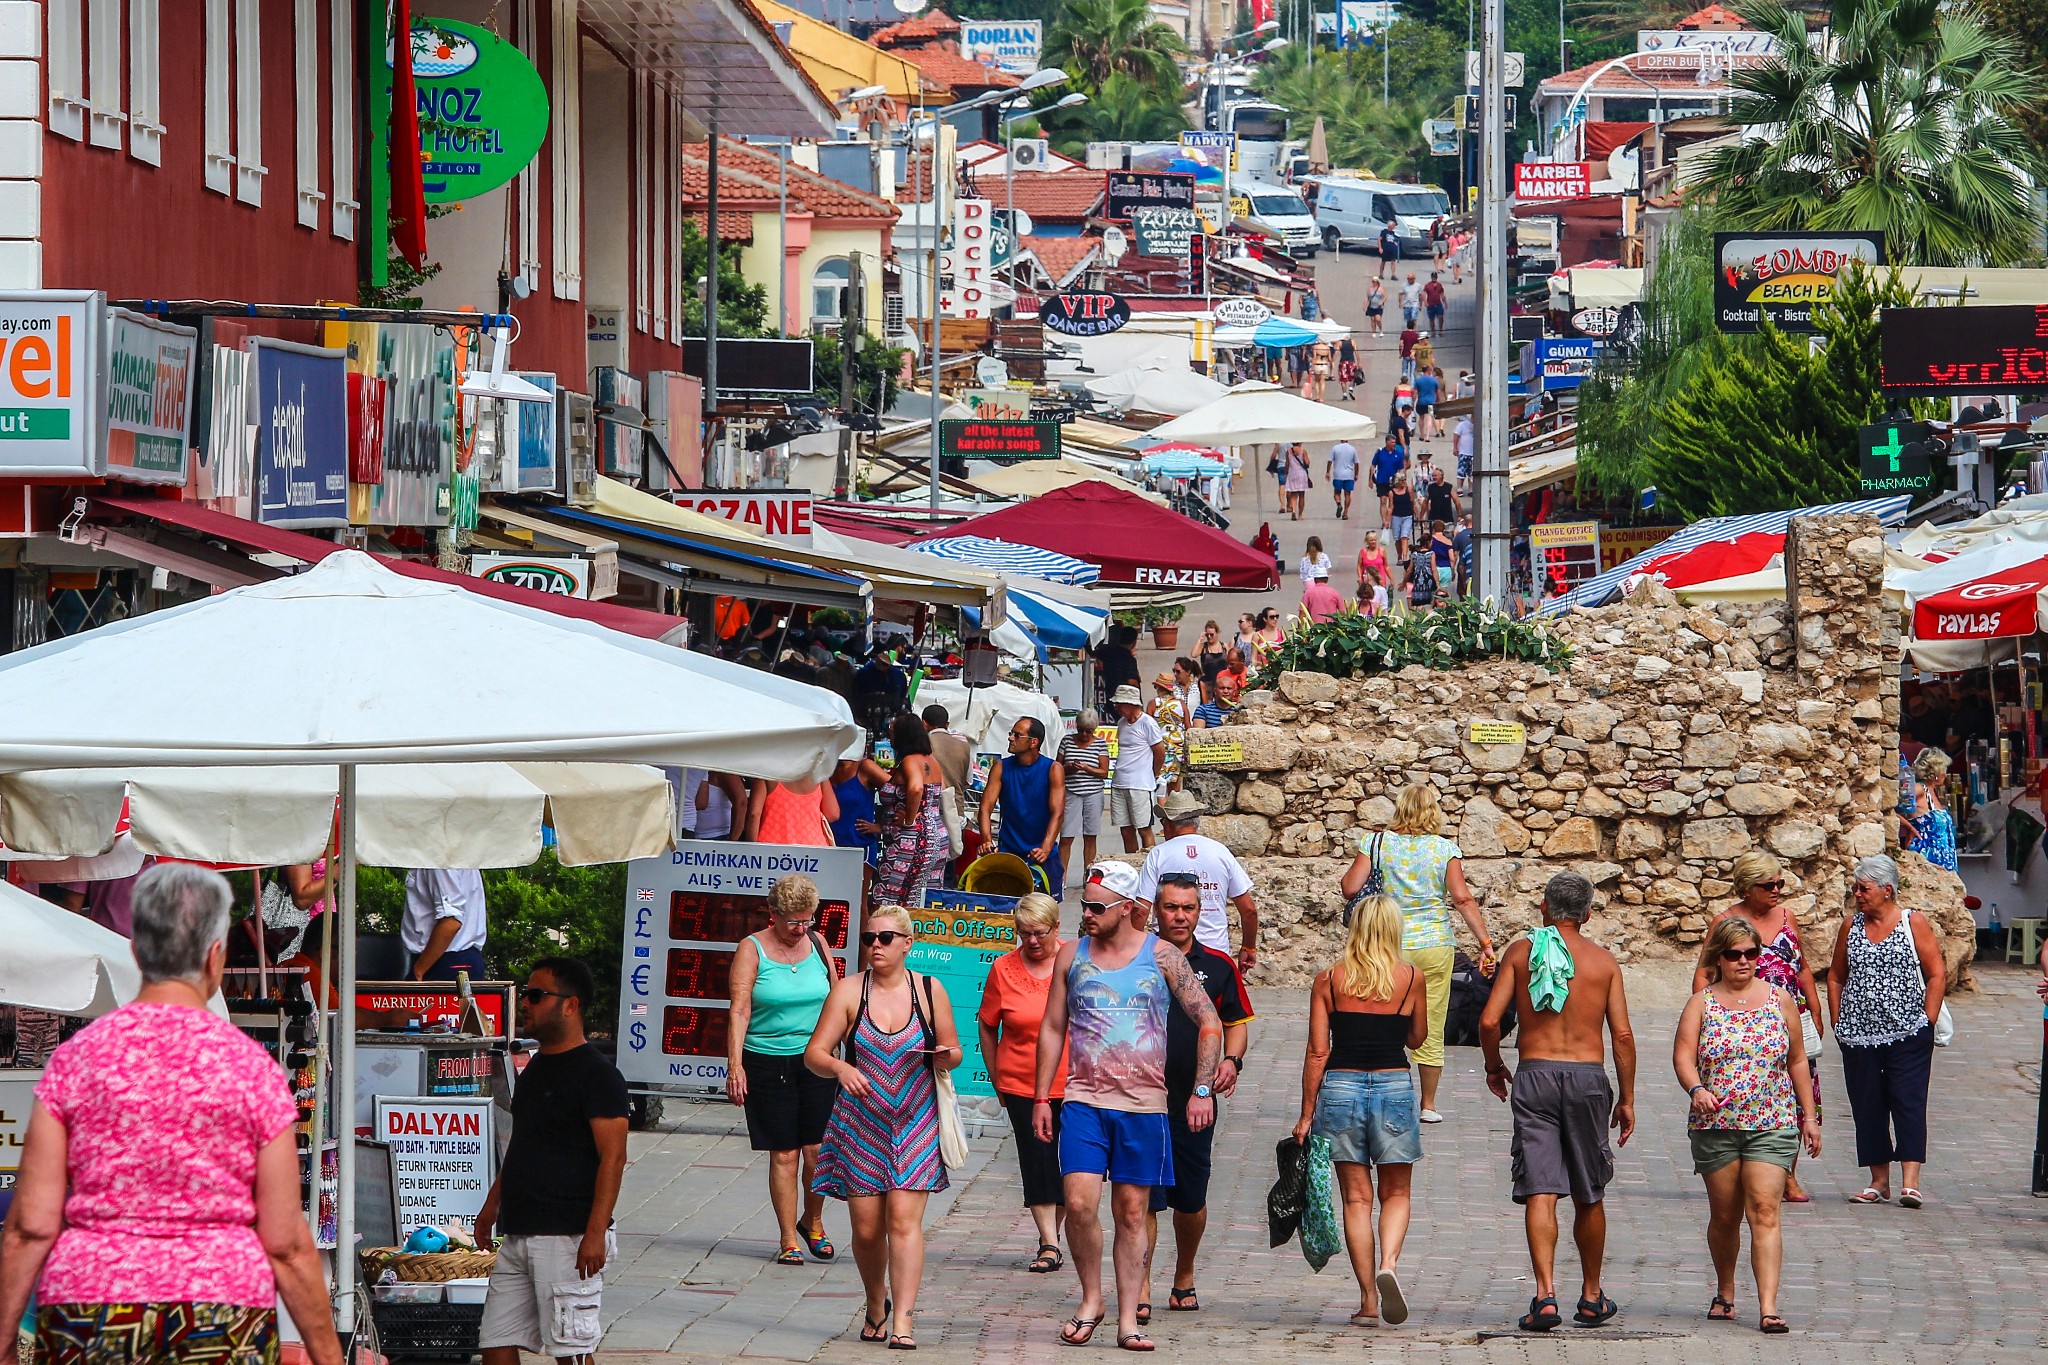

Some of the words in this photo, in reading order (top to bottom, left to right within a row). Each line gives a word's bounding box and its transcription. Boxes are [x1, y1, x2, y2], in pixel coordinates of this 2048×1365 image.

[967, 28, 1036, 45] DORIAN
[1647, 56, 1676, 67] OPEN
[435, 127, 505, 154] HOTEL
[1520, 165, 1585, 179] KARBEL
[1518, 180, 1586, 197] MARKET
[1763, 284, 1813, 299] BEACH
[1059, 294, 1116, 319] VIP
[1219, 301, 1267, 318] SHADOWS
[599, 317, 616, 327] LG
[1723, 308, 1759, 322] Cocktail
[1761, 309, 1777, 321] ar
[1046, 313, 1096, 336] DANCE
[1097, 312, 1127, 333] BAR
[1548, 345, 1589, 358] GÜNAY
[272, 367, 307, 506] elegant
[964, 424, 979, 437] all
[981, 424, 999, 437] the
[1001, 425, 1035, 438] latest
[957, 437, 1004, 450] karaoke
[1006, 439, 1041, 452] songs
[1861, 475, 1930, 491] PHARMACY
[1534, 527, 1565, 537] CHANGE
[1566, 525, 1594, 534] OFFICE
[1600, 532, 1613, 543] NO
[1135, 567, 1221, 586] FRAZER
[671, 850, 764, 870] DEMİRKAN
[766, 853, 820, 873] DÖVİZ
[687, 872, 723, 889] ALIŞ
[736, 875, 763, 888] WE
[635, 907, 652, 938] £
[952, 918, 1015, 940] Offers
[927, 948, 953, 963] Wrap
[631, 964, 651, 996] €
[372, 996, 435, 1009] WARNING
[1077, 997, 1151, 1009] MIAMI
[629, 1021, 647, 1053] $
[437, 1057, 470, 1079] FROM
[669, 1063, 693, 1076] NO
[388, 1111, 480, 1136] DALYAN
[405, 1140, 424, 1154] BATH
[429, 1141, 456, 1155] TURTLE
[457, 1141, 481, 1155] BEACH
[428, 1161, 474, 1173] TRANSFER
[418, 1178, 451, 1190] BUFFET
[452, 1178, 481, 1191] LUNCH
[414, 1213, 436, 1226] BATH
